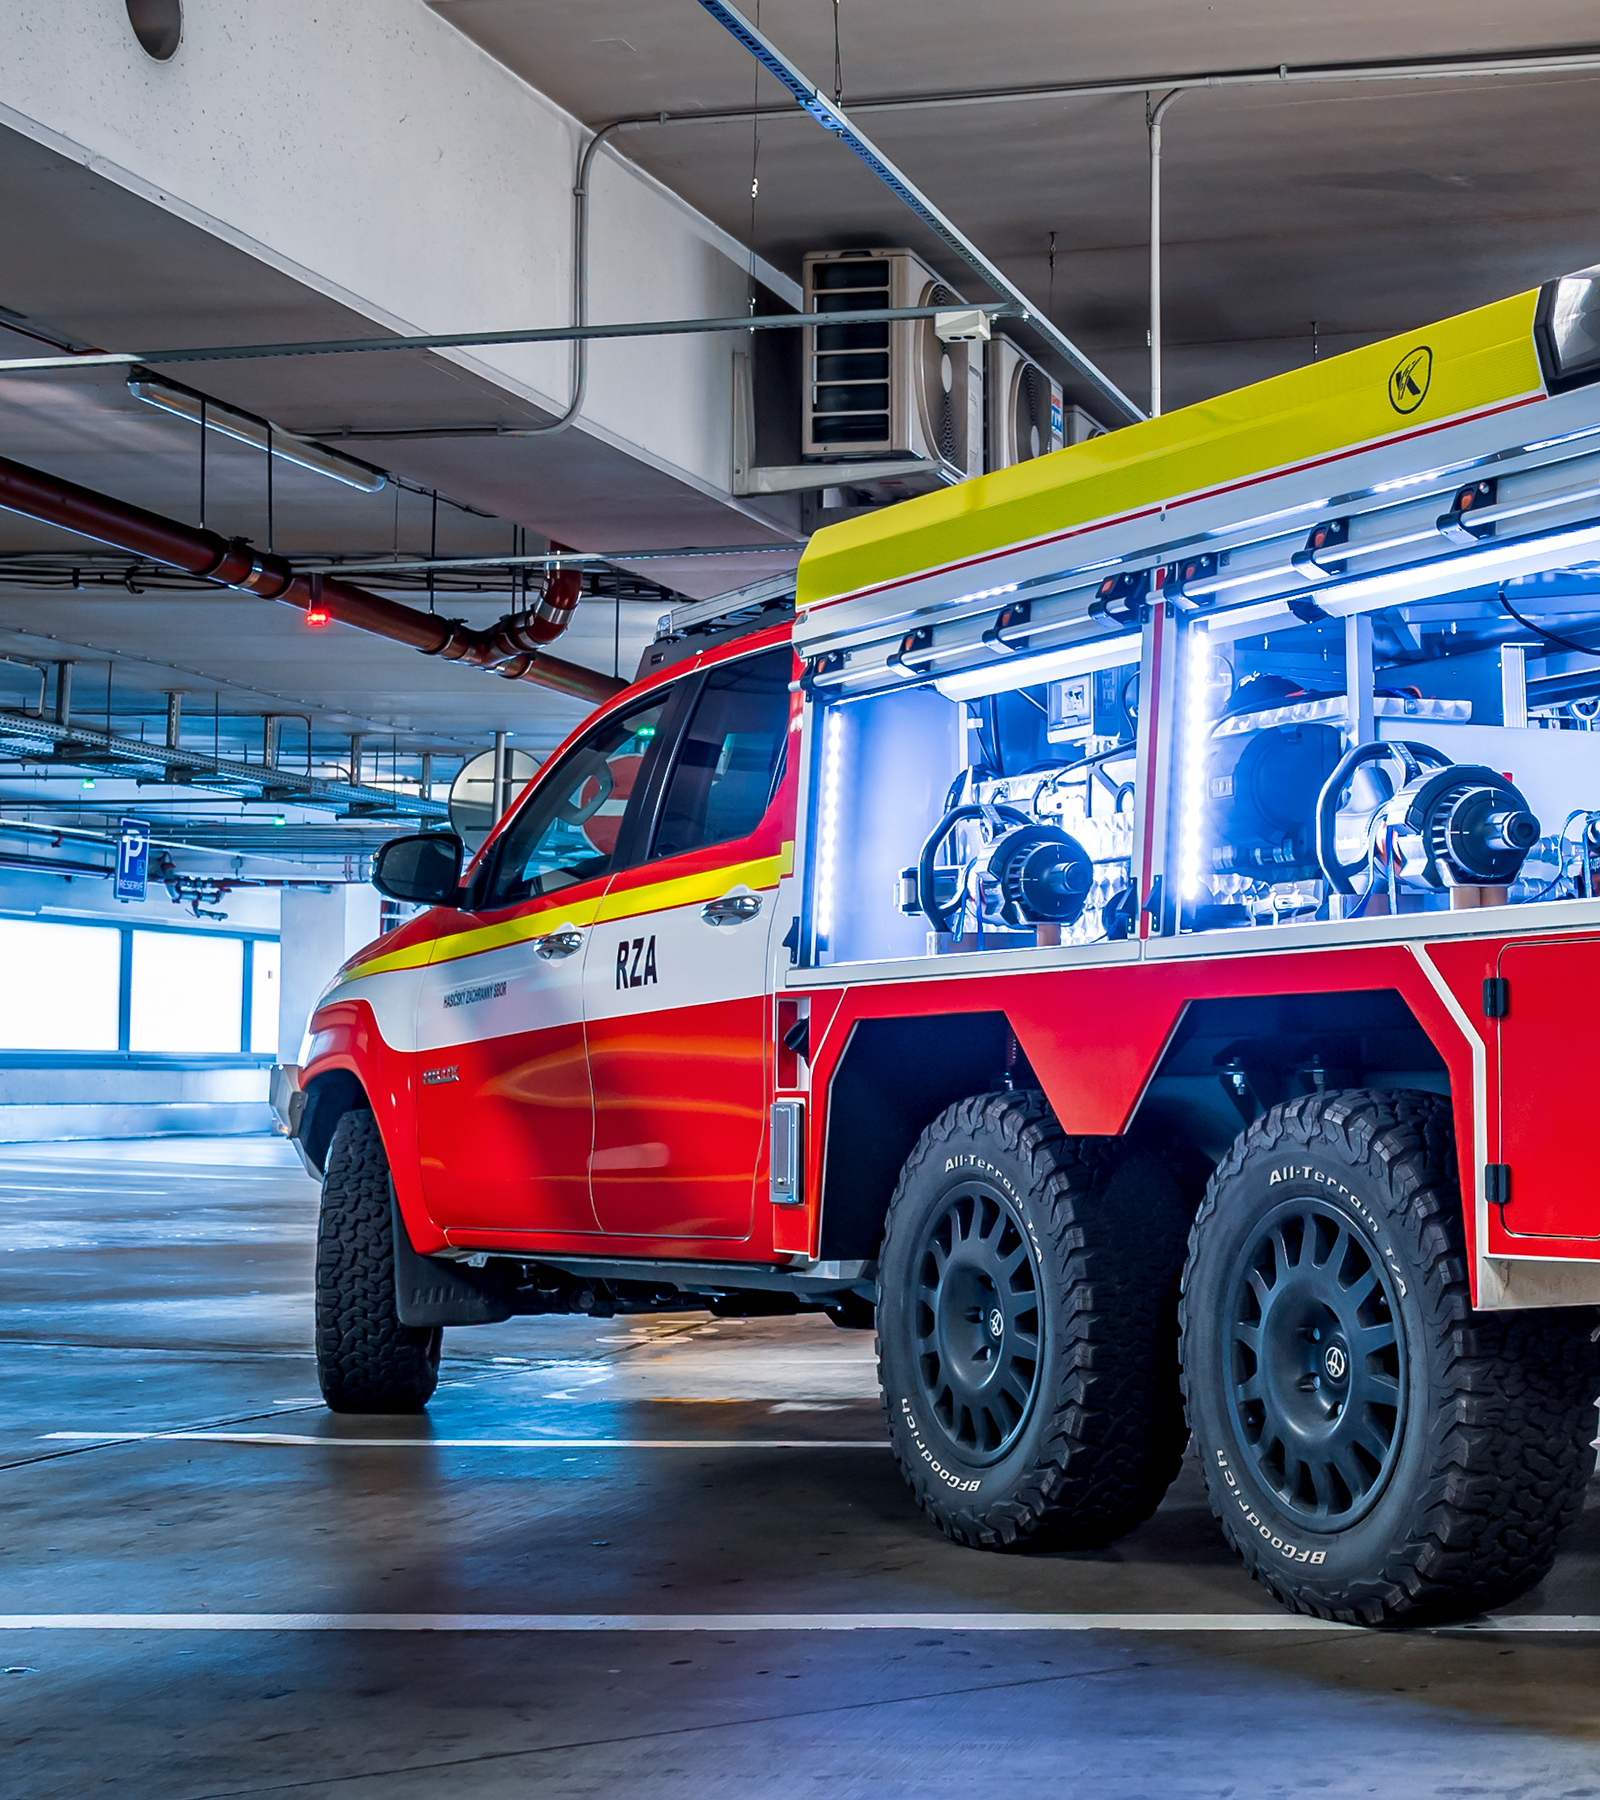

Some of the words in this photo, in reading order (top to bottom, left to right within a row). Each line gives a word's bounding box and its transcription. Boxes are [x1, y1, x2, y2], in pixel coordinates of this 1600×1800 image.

[616, 934, 658, 991] RZA
[1269, 1165, 1379, 1232] All-Terrain
[901, 1398, 981, 1492] BFGoodrich
[1216, 1449, 1327, 1565] BFGoodrich
